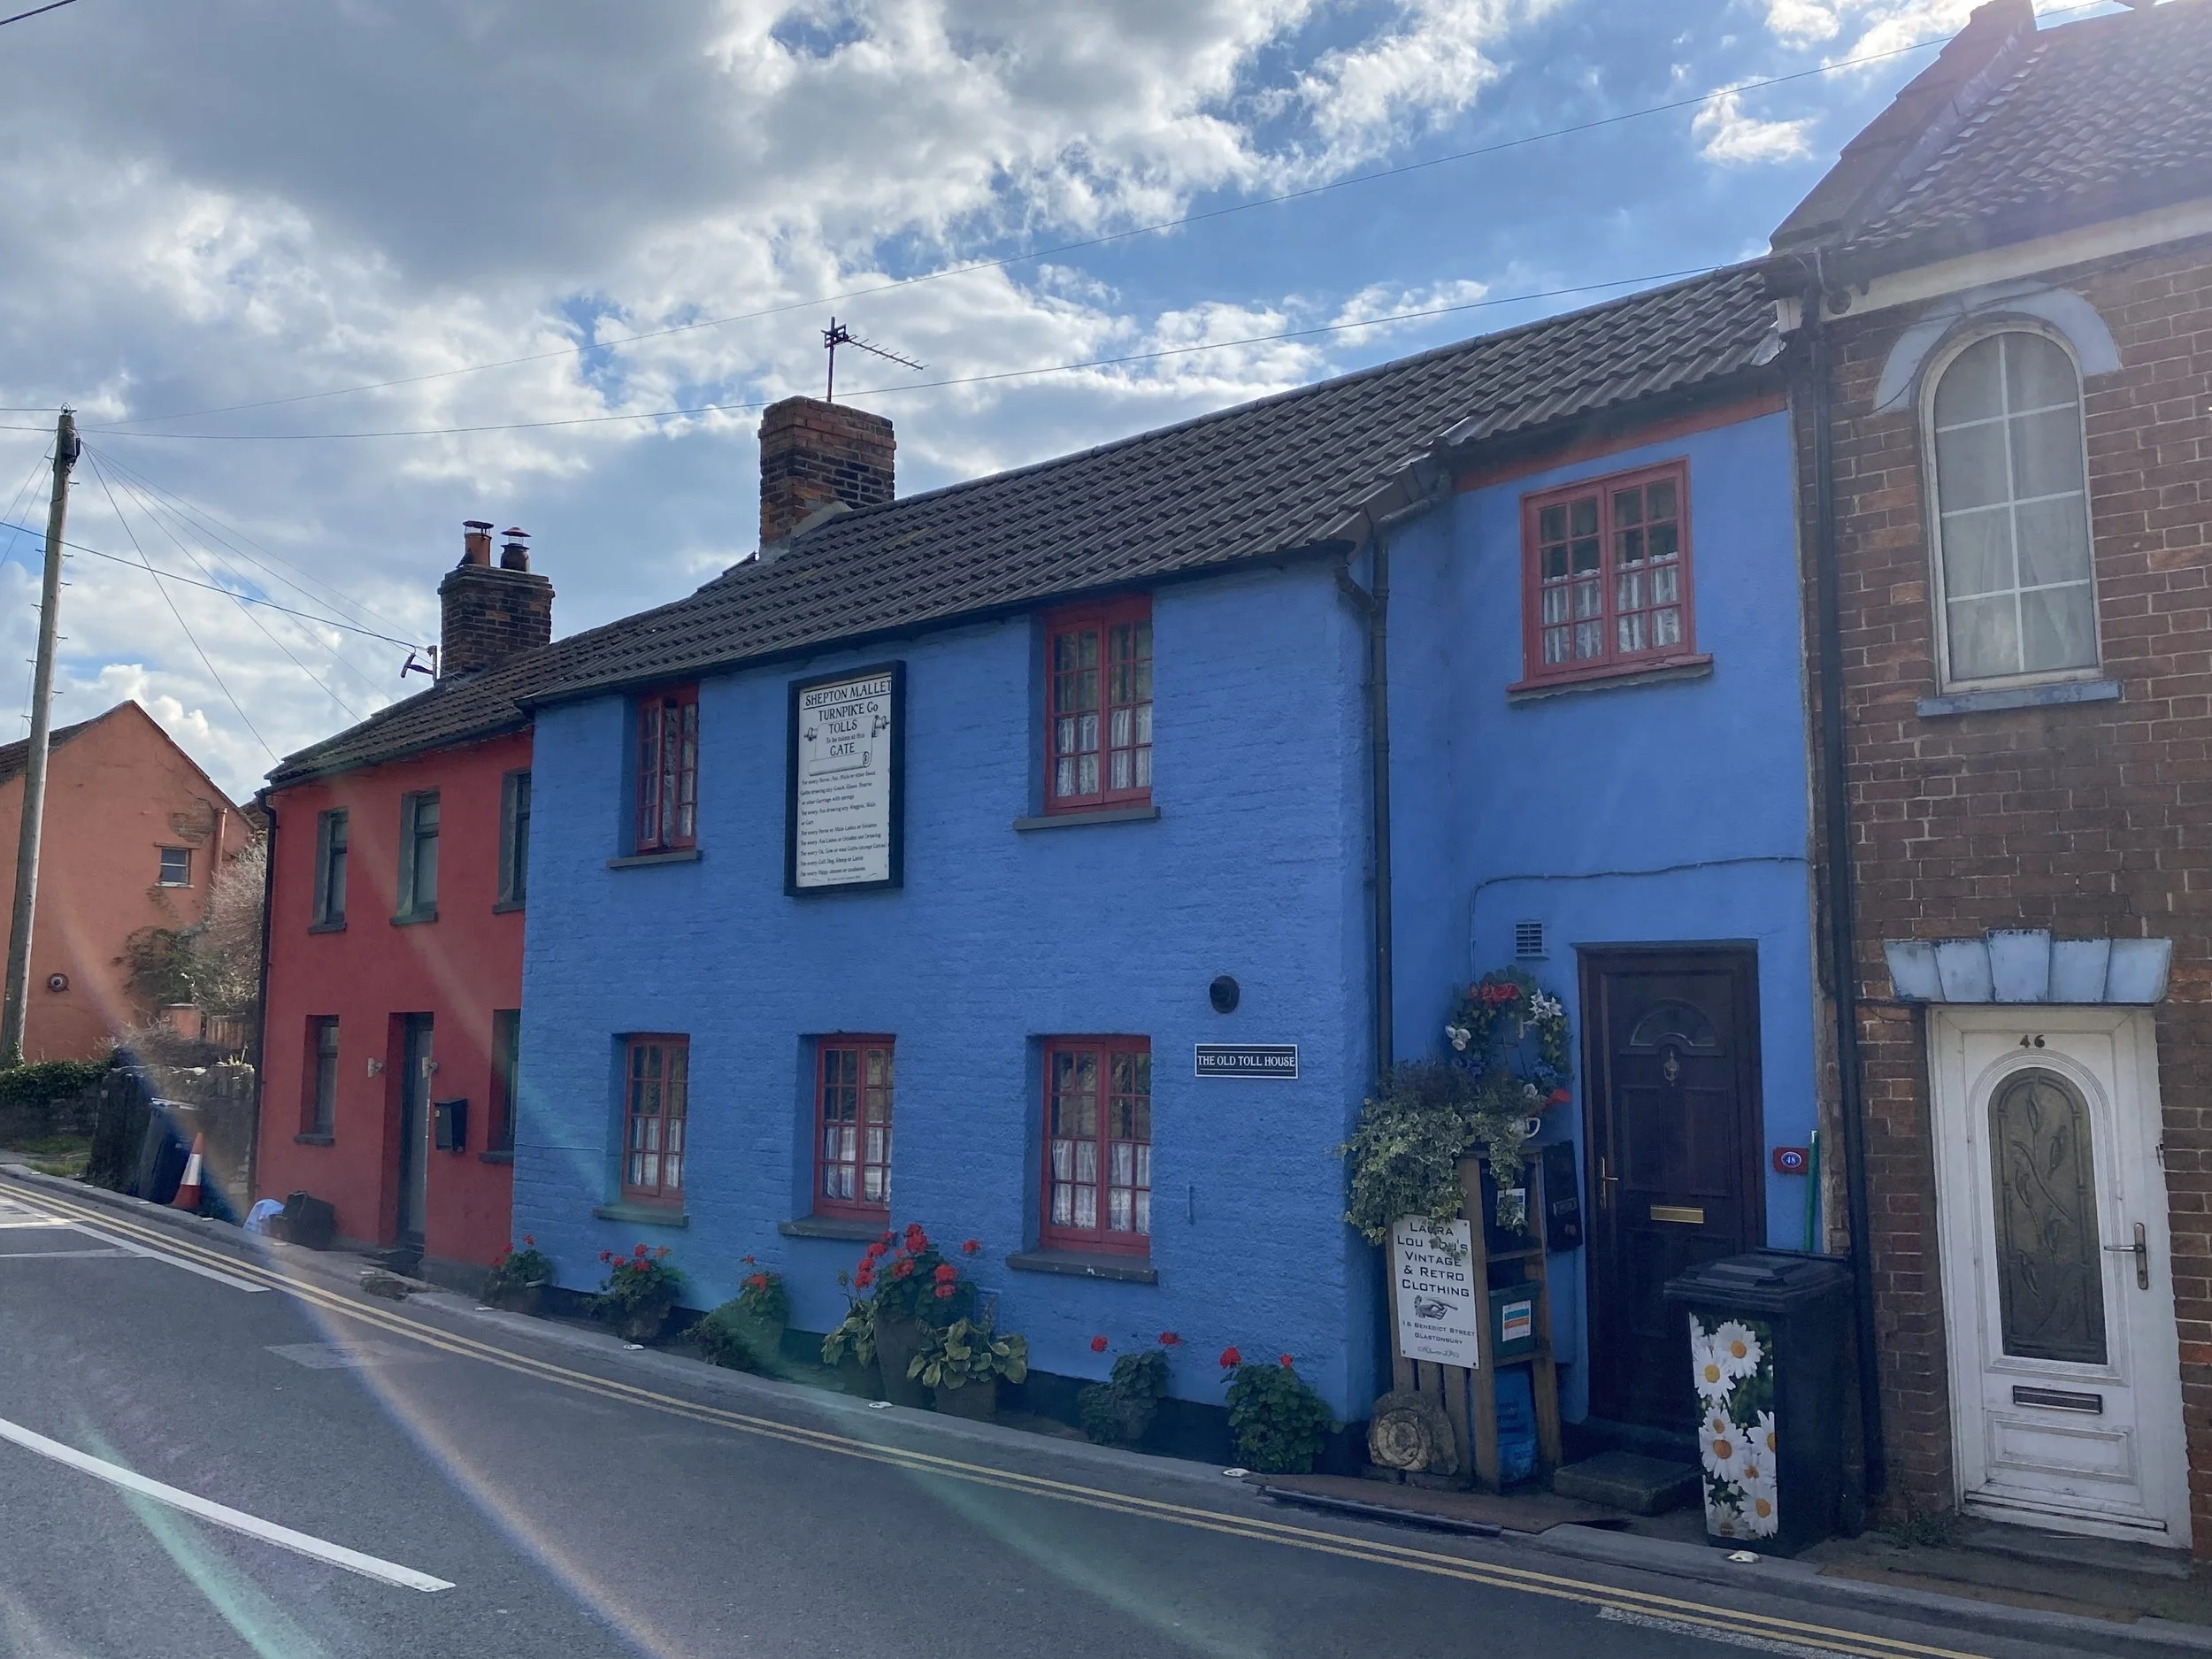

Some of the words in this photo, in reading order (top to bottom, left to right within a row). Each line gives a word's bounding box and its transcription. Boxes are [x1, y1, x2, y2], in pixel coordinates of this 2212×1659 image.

[805, 688, 848, 706] SHEPTON
[850, 680, 891, 698] MALLET
[818, 703, 864, 721] TURNPIKE
[828, 719, 857, 733] TOLLS
[830, 742, 855, 756] GATE
[2019, 1034, 2045, 1048] 46
[1198, 1056, 1215, 1065] THE
[1217, 1056, 1236, 1065] OLD
[1238, 1056, 1263, 1066] TOLL
[1264, 1056, 1295, 1066] HOUSE
[1398, 1235, 1423, 1247] LOU
[1405, 1251, 1462, 1266] VINTAGE
[1403, 1265, 1413, 1274] &
[1420, 1267, 1464, 1281] RETRO
[1402, 1279, 1470, 1297] CLOTHING
[1414, 1323, 1447, 1332] BENEDICT
[1414, 1333, 1463, 1344] GLASTONBURY
